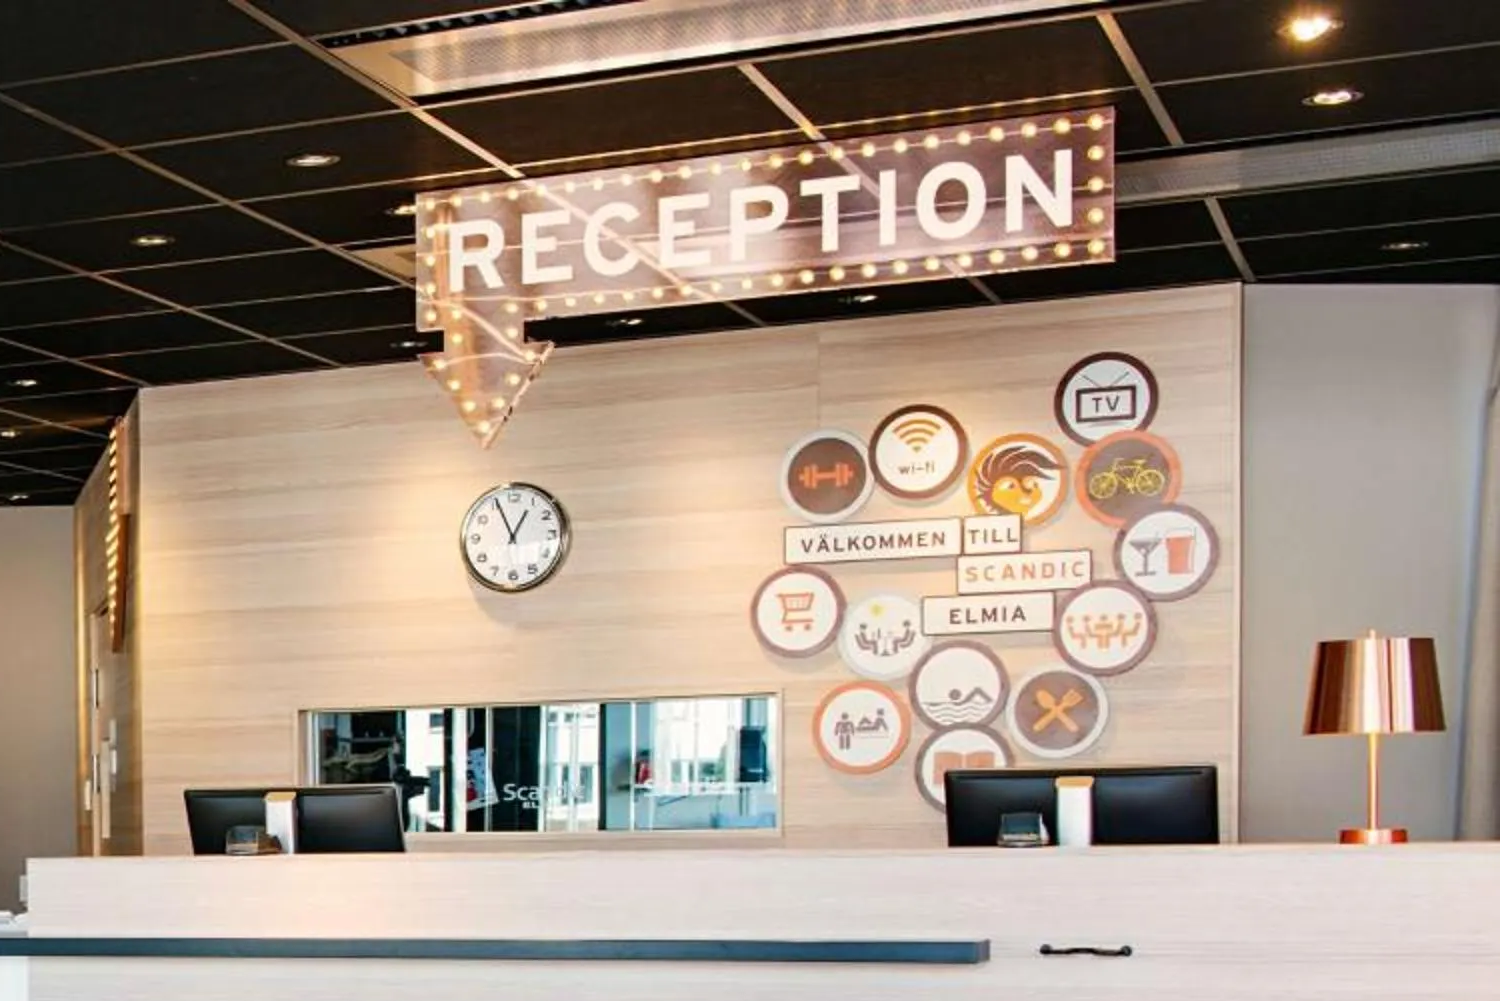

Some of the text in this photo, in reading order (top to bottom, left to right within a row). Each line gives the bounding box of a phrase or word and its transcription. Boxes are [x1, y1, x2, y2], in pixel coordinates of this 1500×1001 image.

[448, 148, 1074, 292] RECEPTION
[1092, 395, 1121, 413] TV
[898, 461, 935, 475] wi-fi
[541, 510, 552, 521] 2
[471, 533, 481, 545] 9
[547, 529, 556, 541] 3
[800, 526, 1019, 554] VÄLKOMMEN TILL
[508, 570, 518, 581] 6
[527, 564, 538, 575] 5
[965, 562, 1086, 583] SCANDIC
[949, 607, 1027, 625] ELMIA
